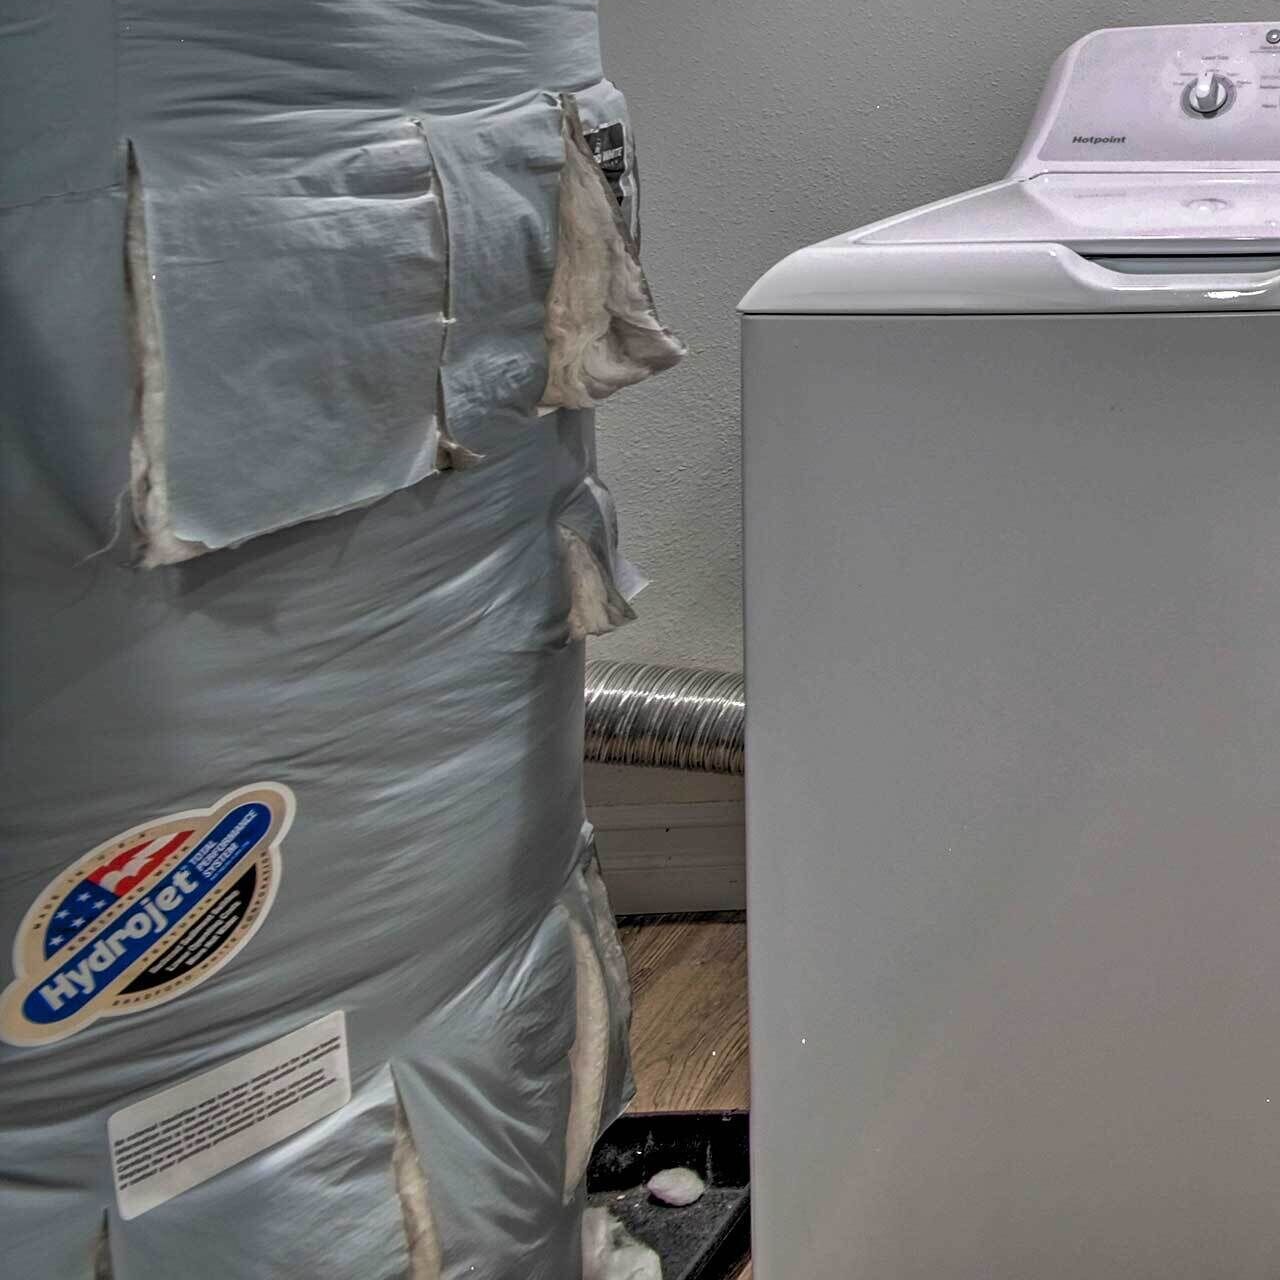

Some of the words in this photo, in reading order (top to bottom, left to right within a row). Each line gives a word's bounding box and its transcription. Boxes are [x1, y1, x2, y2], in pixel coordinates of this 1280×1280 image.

[1072, 135, 1126, 144] Hotpoint
[195, 809, 259, 871] PERFORMANCE
[203, 842, 240, 879] SYSTEM
[37, 868, 200, 1012] Hydrojet
